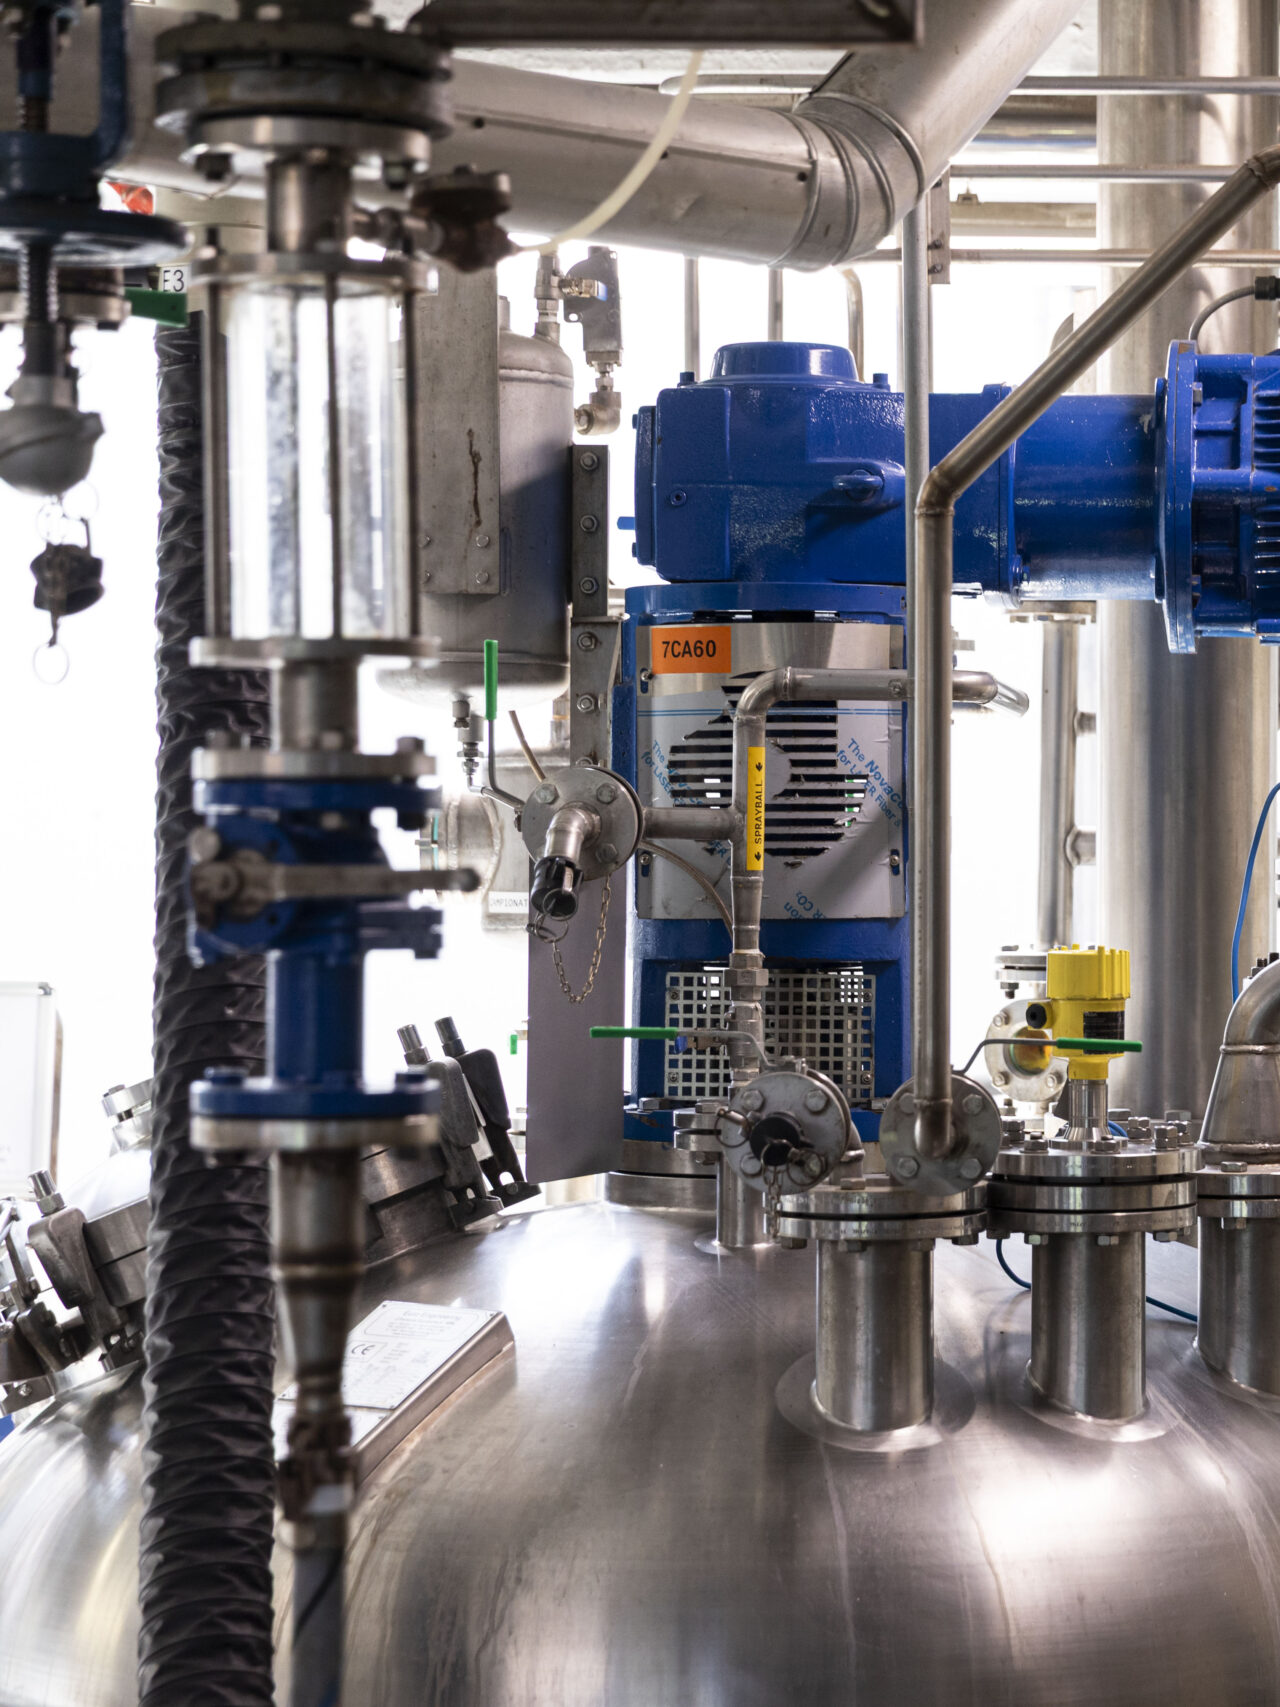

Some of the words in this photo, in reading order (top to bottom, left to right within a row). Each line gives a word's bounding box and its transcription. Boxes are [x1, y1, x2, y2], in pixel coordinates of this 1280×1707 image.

[163, 269, 185, 292] E3
[661, 640, 717, 659] 7CA60
[847, 738, 866, 762] The
[836, 749, 852, 767] for
[874, 795, 897, 821] Fiber
[754, 780, 764, 845] SPRAYBALL
